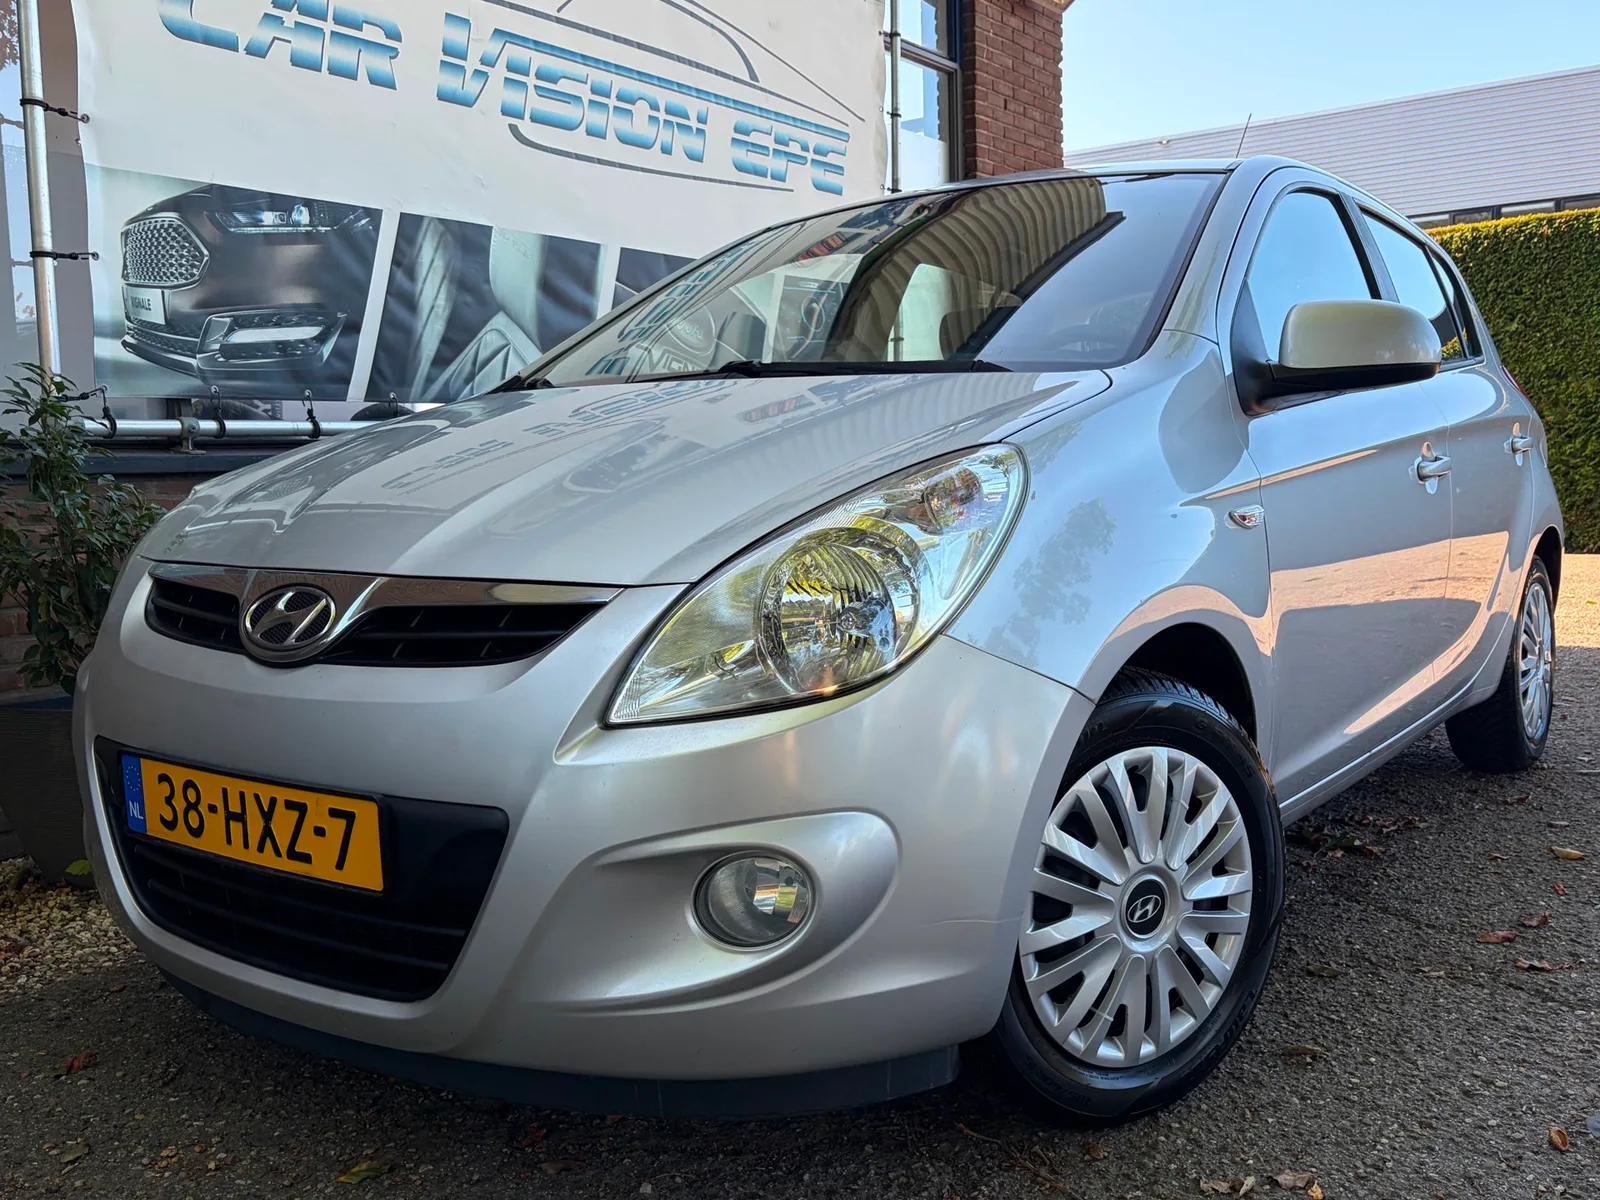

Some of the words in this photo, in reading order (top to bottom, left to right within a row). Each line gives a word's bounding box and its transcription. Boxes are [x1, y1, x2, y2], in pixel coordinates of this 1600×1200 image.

[157, 0, 402, 90] CAR
[437, 12, 709, 163] VISION
[730, 118, 848, 196] EPE
[129, 800, 144, 821] NL
[157, 773, 357, 871] 38-HXZ-7
